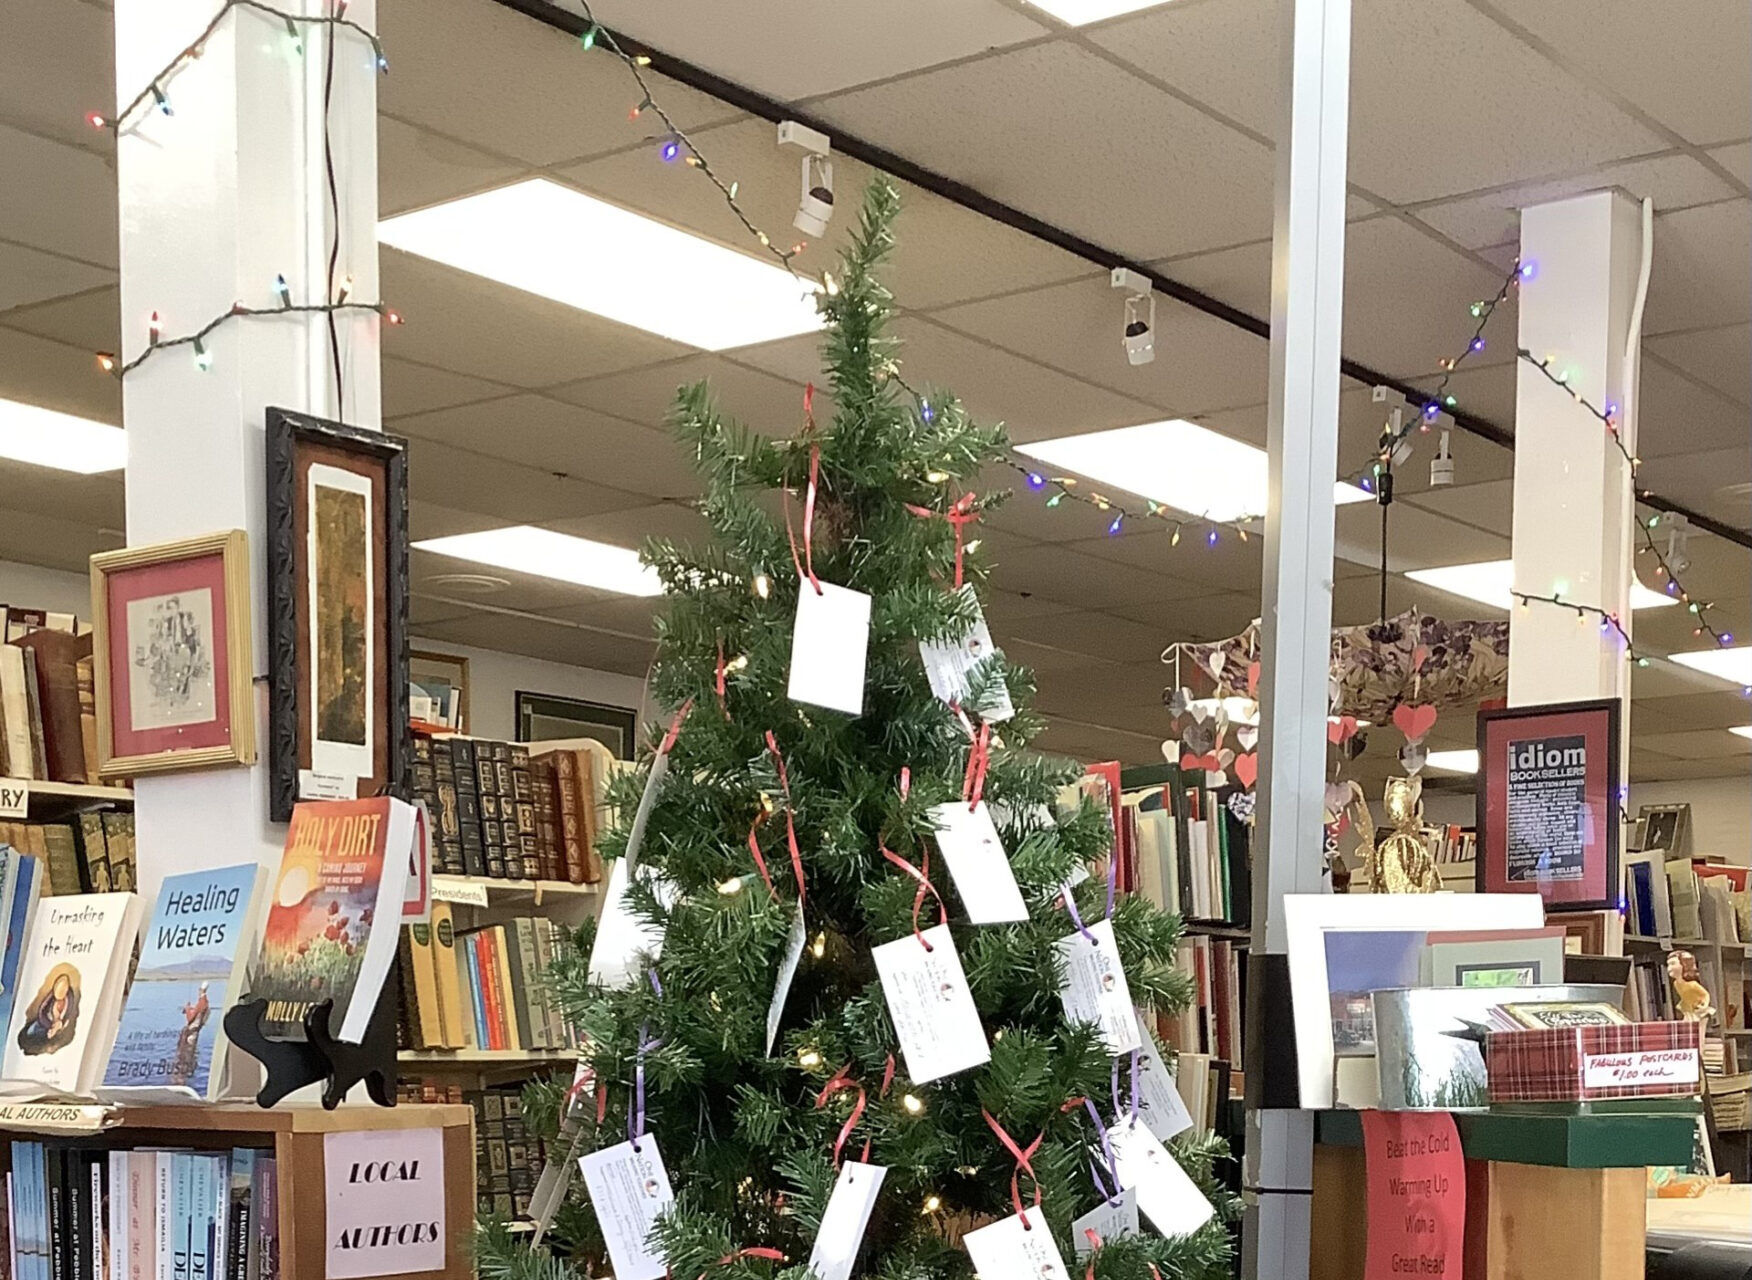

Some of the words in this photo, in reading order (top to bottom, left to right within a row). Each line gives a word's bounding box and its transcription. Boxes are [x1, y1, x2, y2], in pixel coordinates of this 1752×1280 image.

[1508, 744, 1586, 770] idiom
[1510, 767, 1586, 781] BOOKSELLERS
[294, 816, 339, 856] HOLY
[338, 813, 381, 856] DIRT
[165, 884, 240, 917] Healing
[51, 904, 104, 928] Unmasking
[43, 936, 60, 957] the
[66, 935, 94, 954] Heart
[156, 922, 226, 950] Waters
[266, 1000, 297, 1022] MOLLY
[117, 1060, 151, 1079] Brady
[1589, 1055, 1633, 1069] FABULOUS
[1639, 1052, 1694, 1067] POSTCARDS
[1642, 1067, 1674, 1078] each
[16, 1105, 80, 1121] AUTHORS
[1386, 1140, 1408, 1158] Beat
[1410, 1138, 1426, 1156] the
[1428, 1132, 1450, 1154] Cold
[349, 1160, 422, 1184] LOCAL
[1389, 1177, 1432, 1199] Warming
[1434, 1173, 1449, 1197] Up
[238, 1209, 247, 1255] IMAGINING
[334, 1221, 440, 1250] AUTHORS
[1405, 1214, 1426, 1233] With
[1429, 1219, 1435, 1233] a
[1391, 1253, 1418, 1273] Great
[1420, 1253, 1445, 1274] Read
